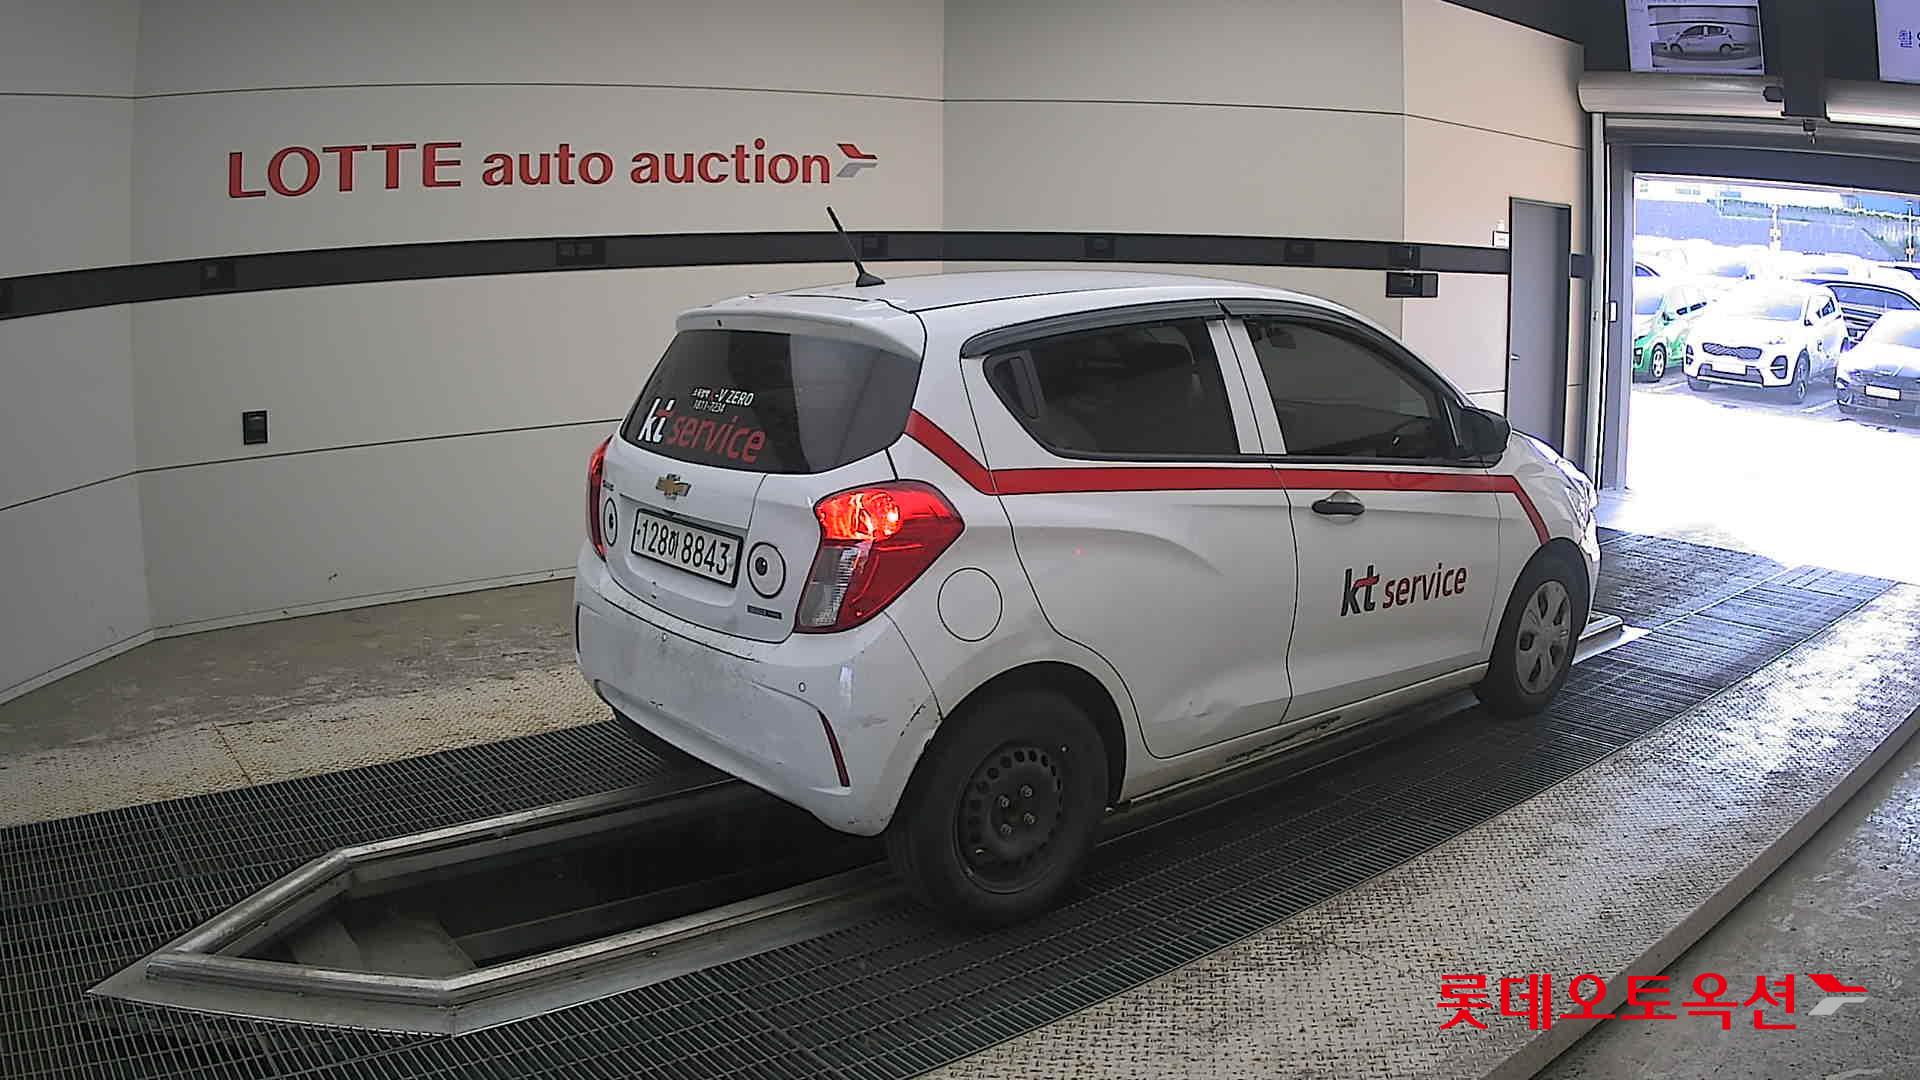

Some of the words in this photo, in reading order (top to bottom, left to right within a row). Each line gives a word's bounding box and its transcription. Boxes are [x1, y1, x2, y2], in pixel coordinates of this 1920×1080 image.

[228, 142, 462, 198] LOTTE
[481, 143, 615, 186] auto
[629, 138, 833, 184] auction
[725, 389, 755, 407] ZERO
[637, 397, 675, 442] kt
[665, 415, 768, 464] service
[681, 531, 730, 576] 8843
[1340, 563, 1380, 617] kt
[1382, 562, 1467, 609] service
